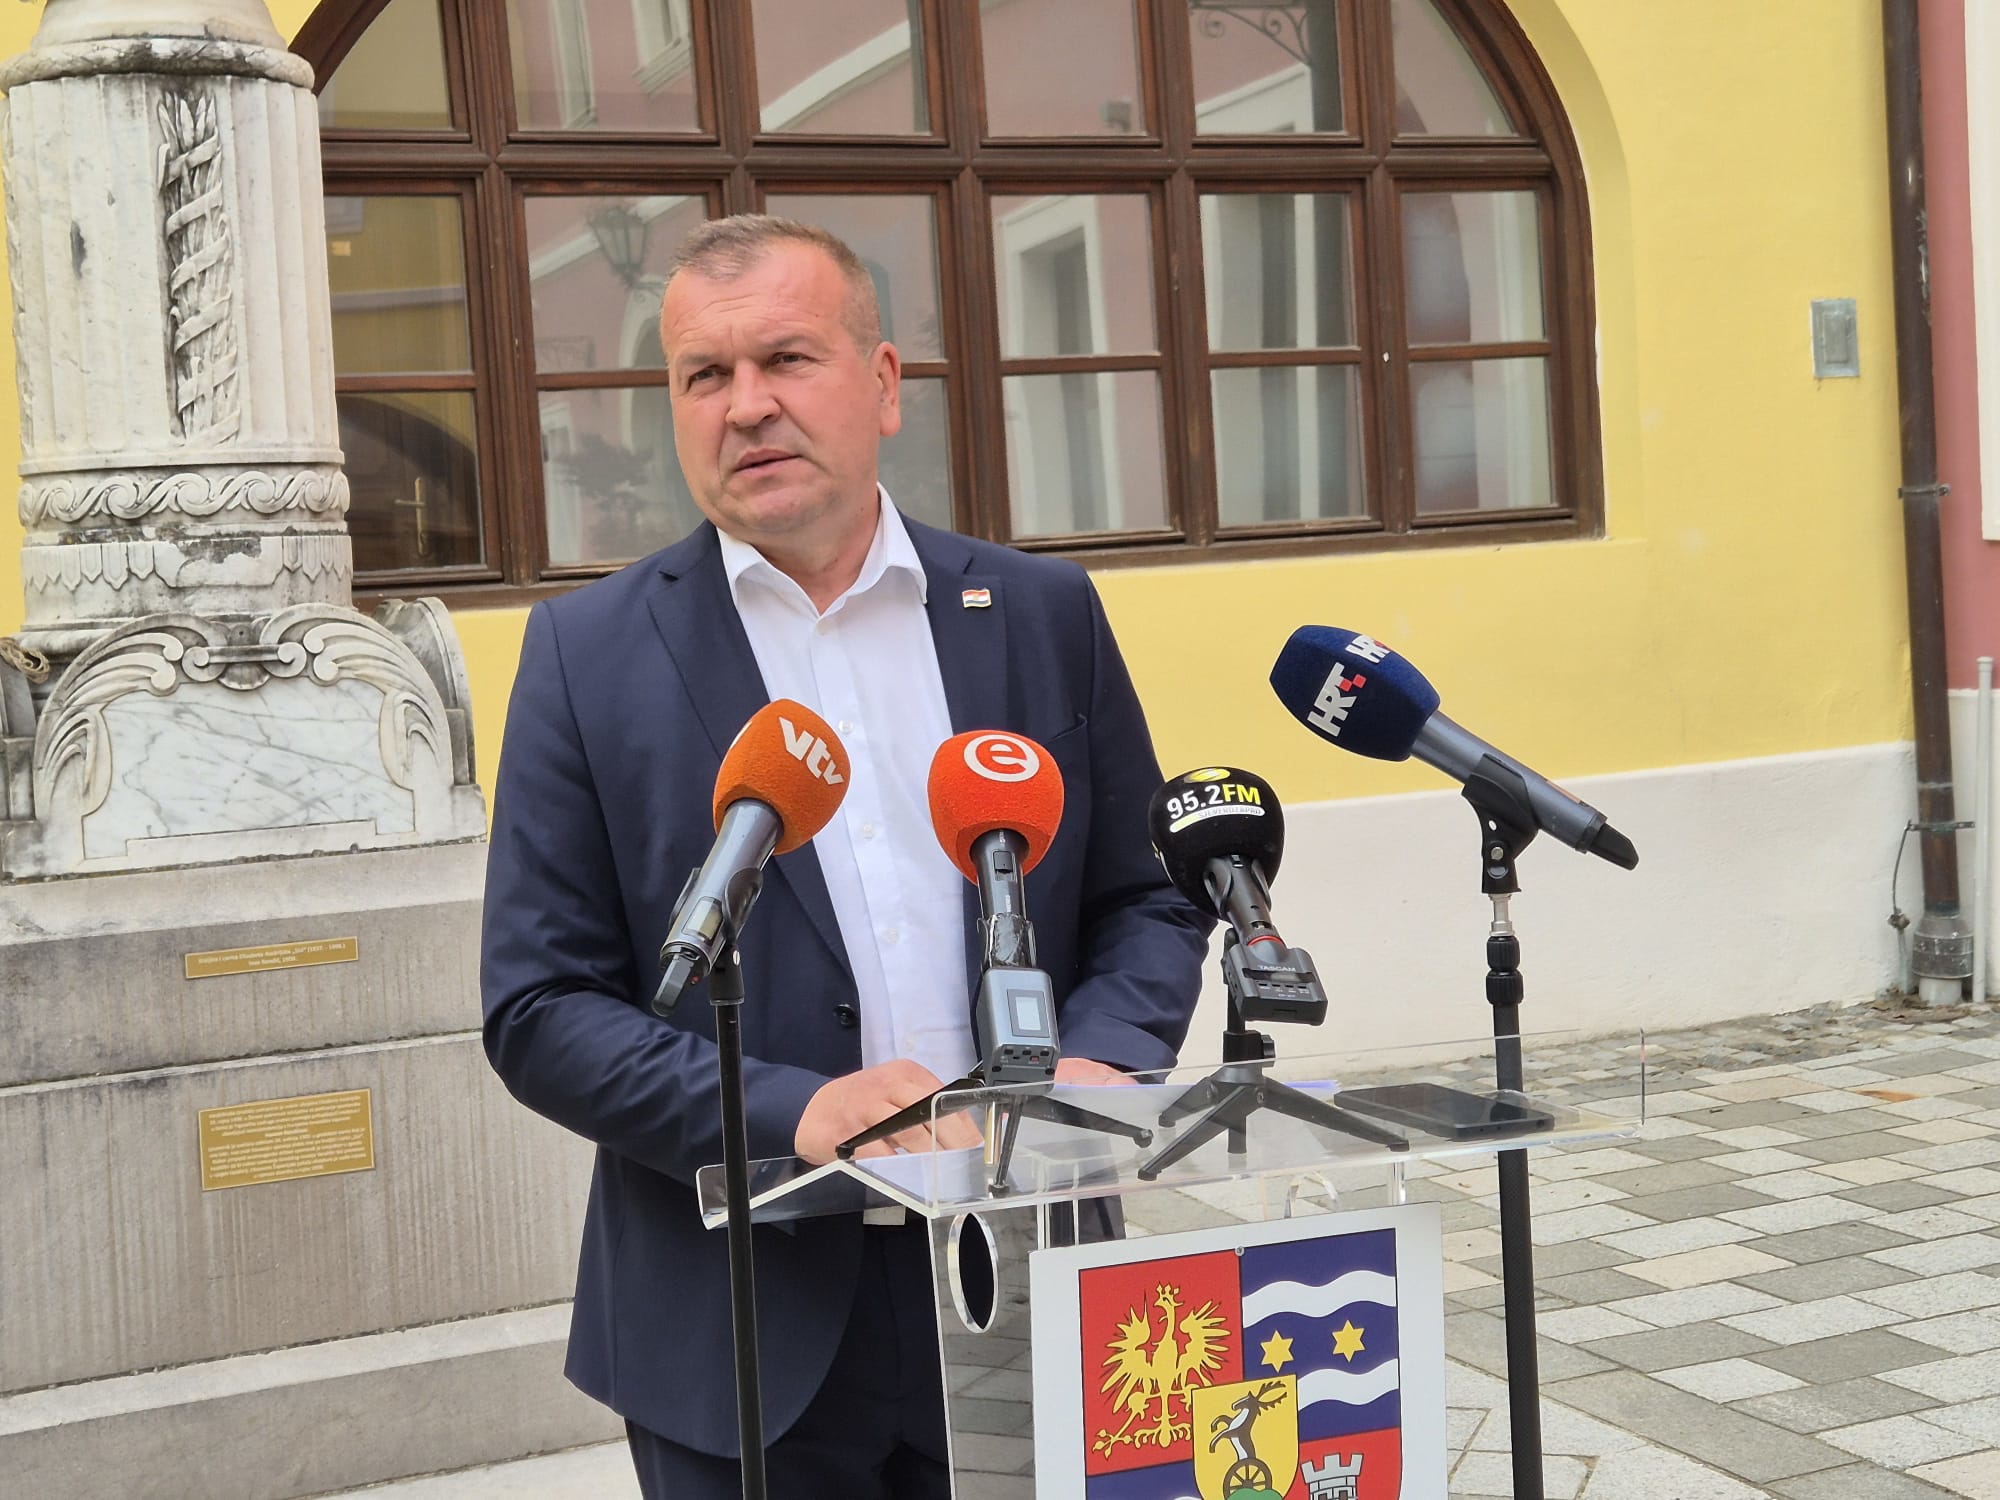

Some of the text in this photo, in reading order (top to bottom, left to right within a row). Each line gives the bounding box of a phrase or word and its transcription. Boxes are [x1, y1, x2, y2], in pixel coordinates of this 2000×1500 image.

[1307, 662, 1367, 737] HRT
[975, 738, 1029, 776] e
[1166, 783, 1261, 820] 95.2FM
[1257, 964, 1297, 972] TASCAM
